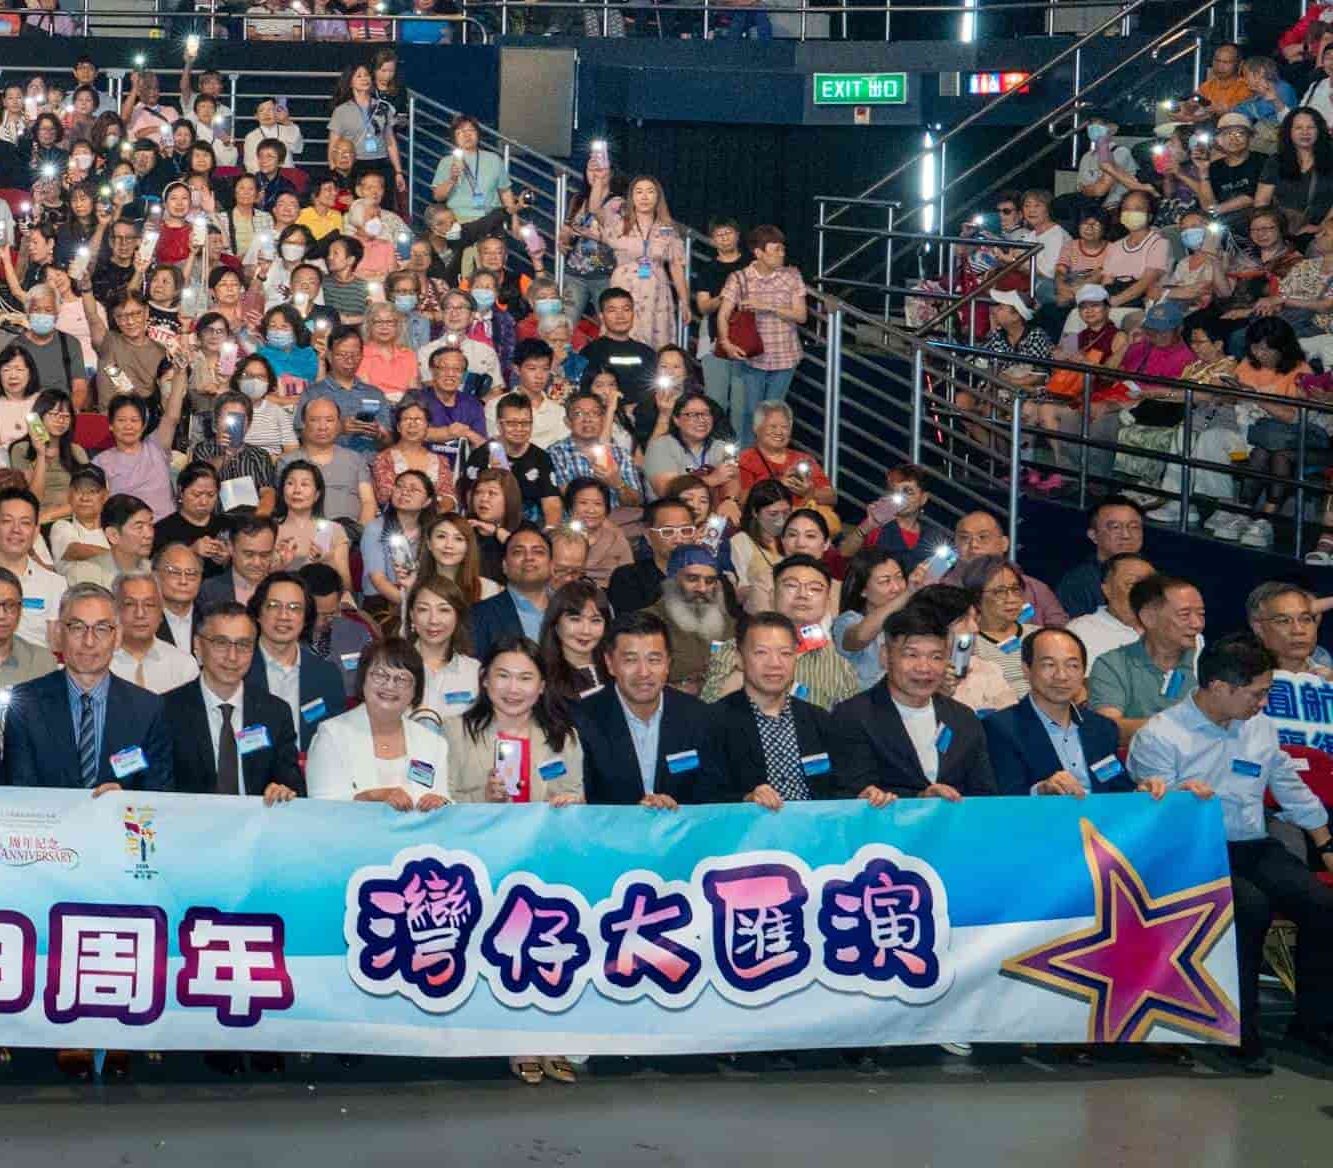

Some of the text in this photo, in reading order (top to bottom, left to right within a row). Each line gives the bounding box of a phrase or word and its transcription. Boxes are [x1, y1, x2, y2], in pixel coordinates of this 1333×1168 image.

[822, 79, 898, 99] EXIT 出口
[0, 848, 73, 864] ANNIVERSARY
[351, 856, 941, 998] 灣仔大匯演
